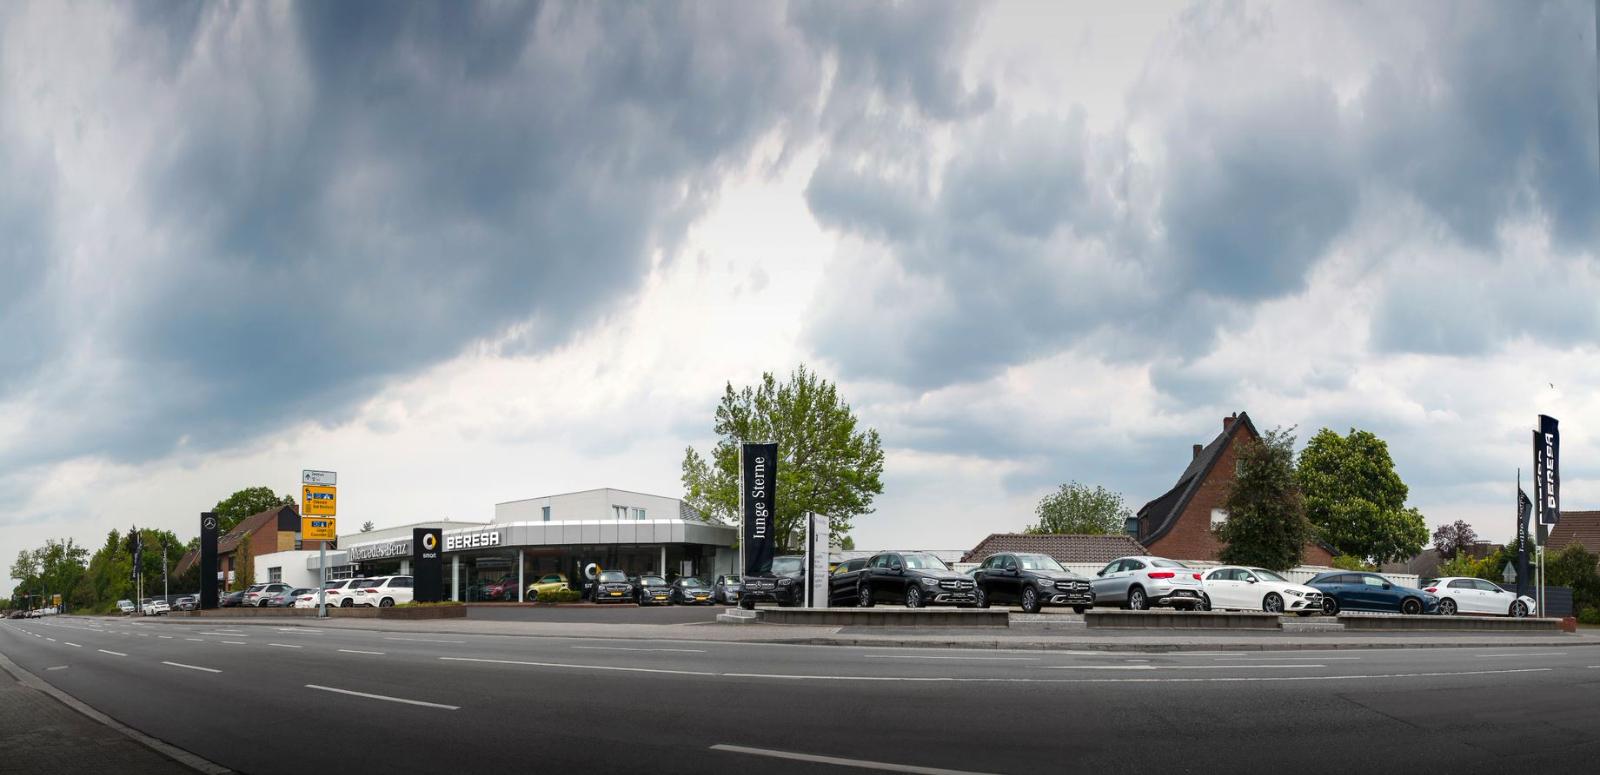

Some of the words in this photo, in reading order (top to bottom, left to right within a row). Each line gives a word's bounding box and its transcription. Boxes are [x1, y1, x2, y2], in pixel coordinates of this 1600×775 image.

[752, 456, 765, 499] Sterne
[752, 502, 769, 540] Junge
[350, 542, 408, 561] Mercedes-Benz
[447, 531, 500, 550] BERESA
